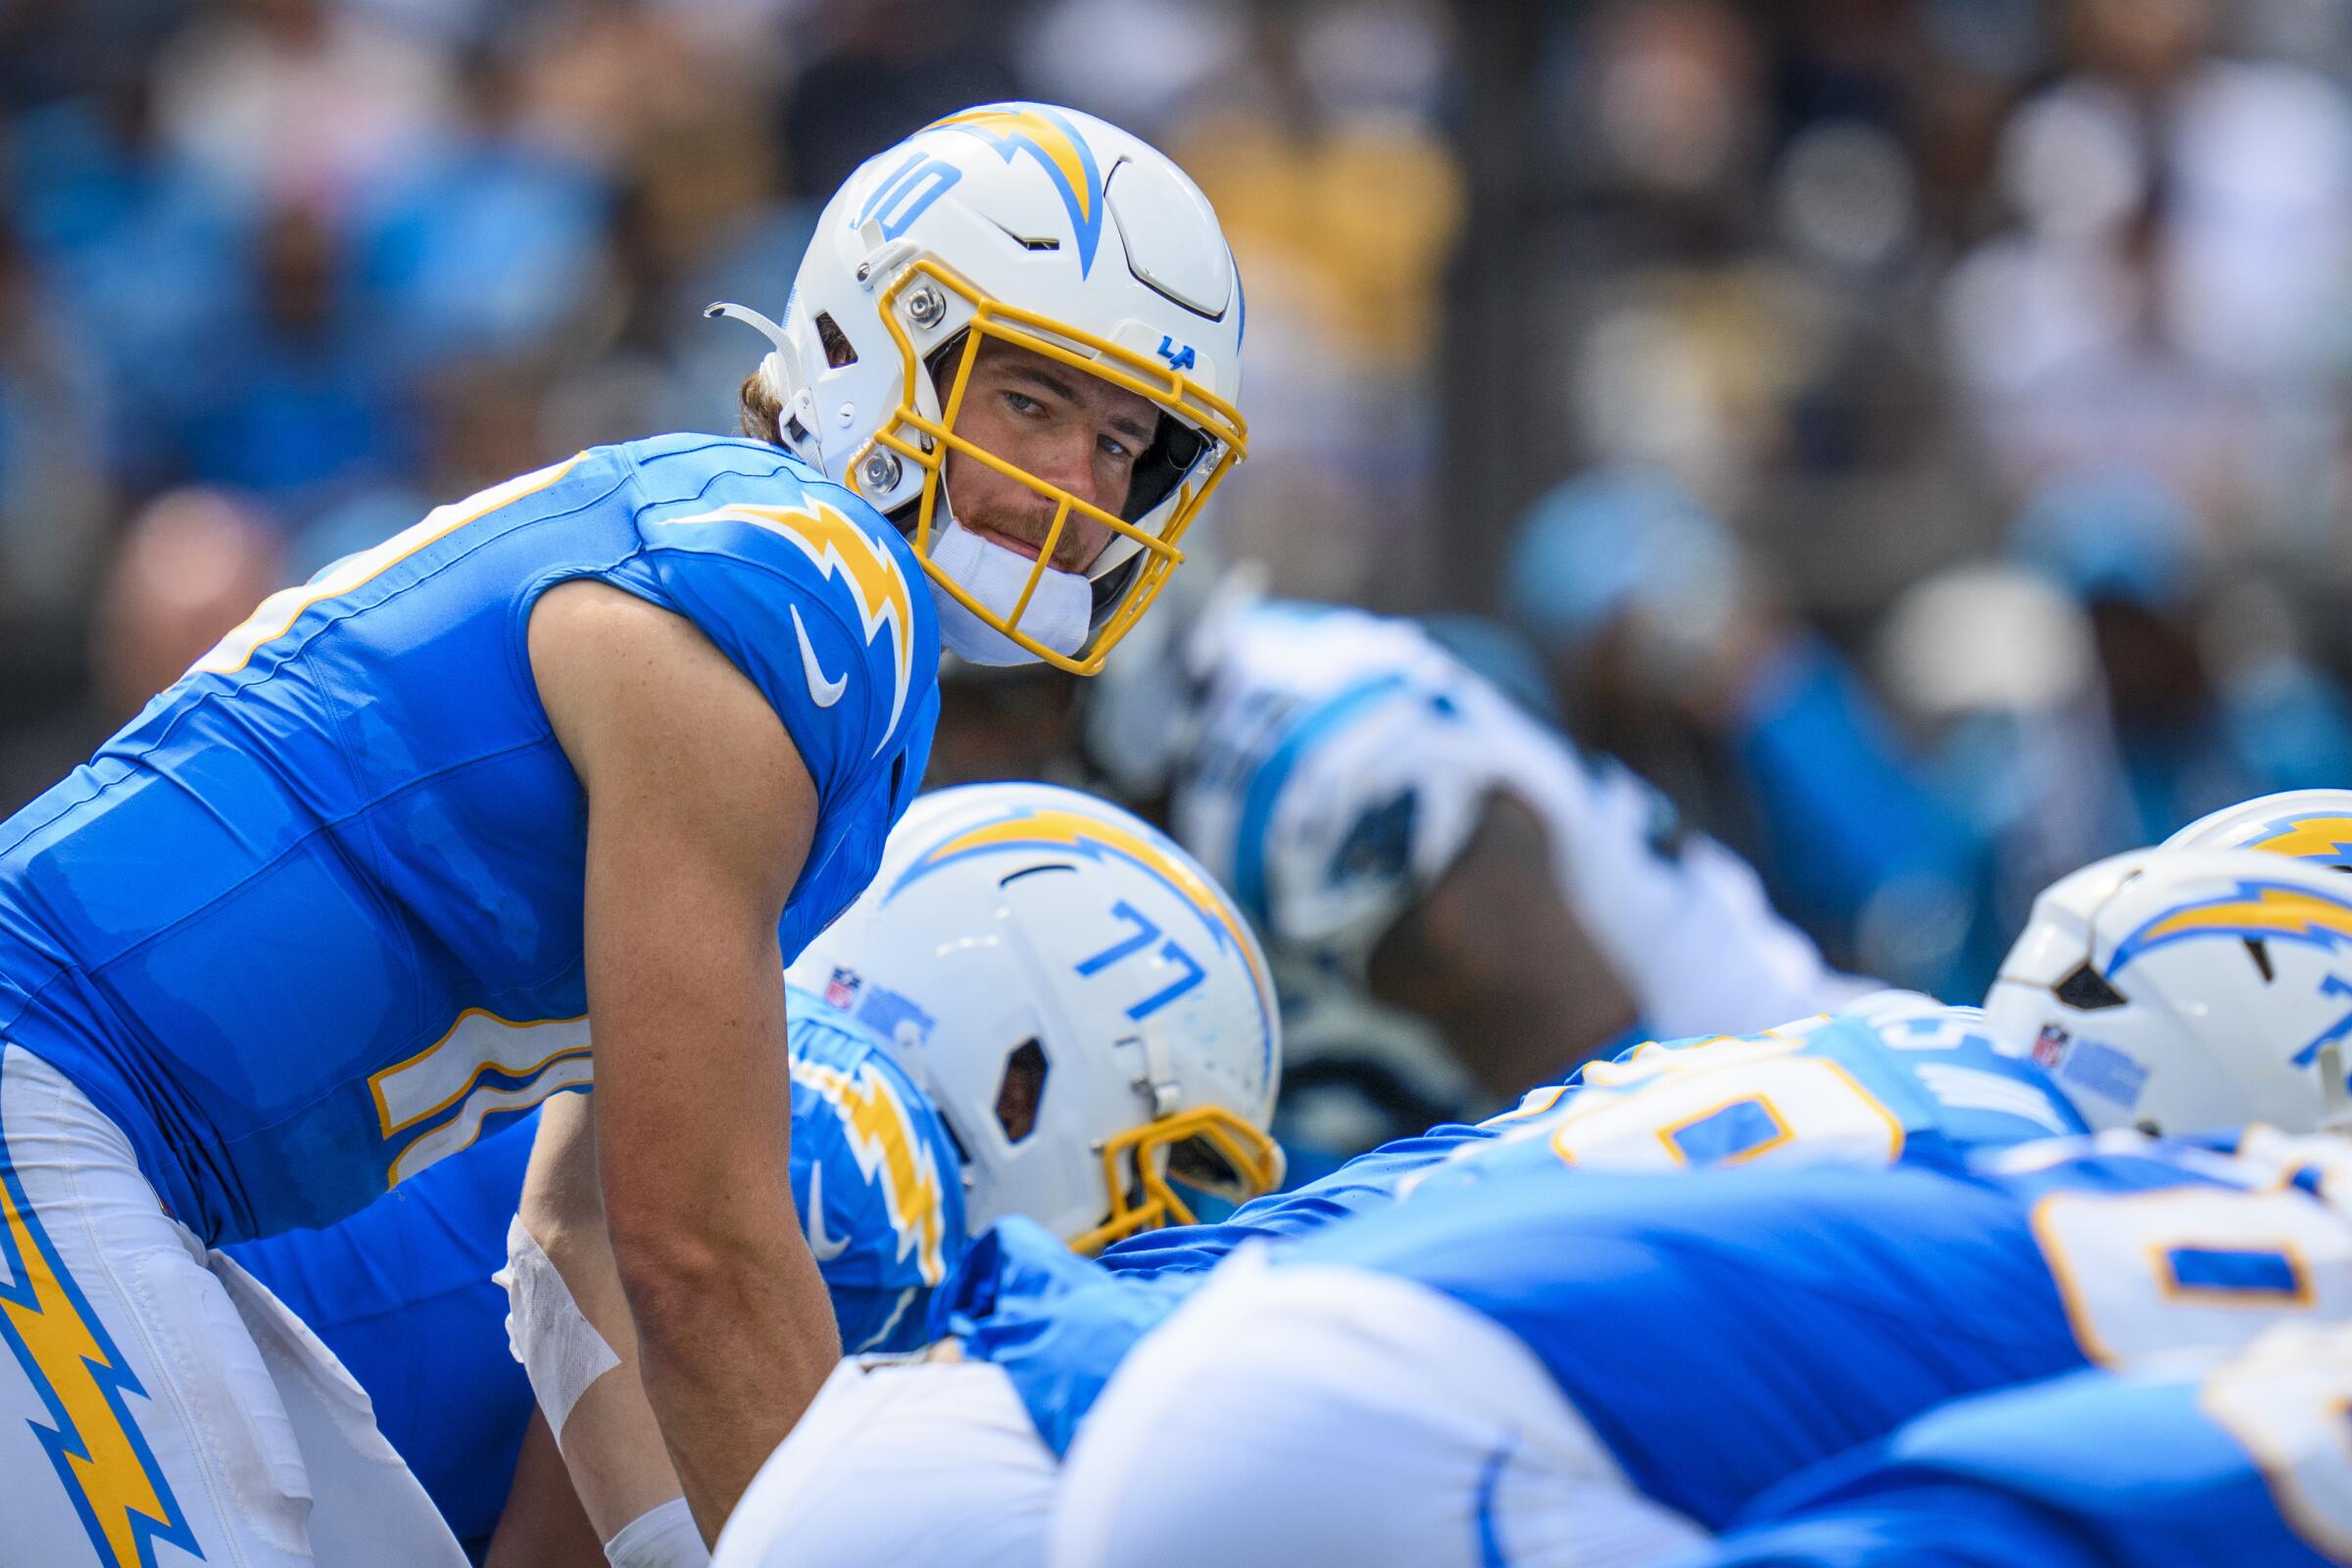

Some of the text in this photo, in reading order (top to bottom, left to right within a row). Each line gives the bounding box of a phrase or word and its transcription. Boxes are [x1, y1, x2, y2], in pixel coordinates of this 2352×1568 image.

[848, 152, 962, 243] 10
[1156, 335, 1196, 371] LA
[1075, 898, 1206, 1021] 77
[2290, 974, 2352, 1099] 7
